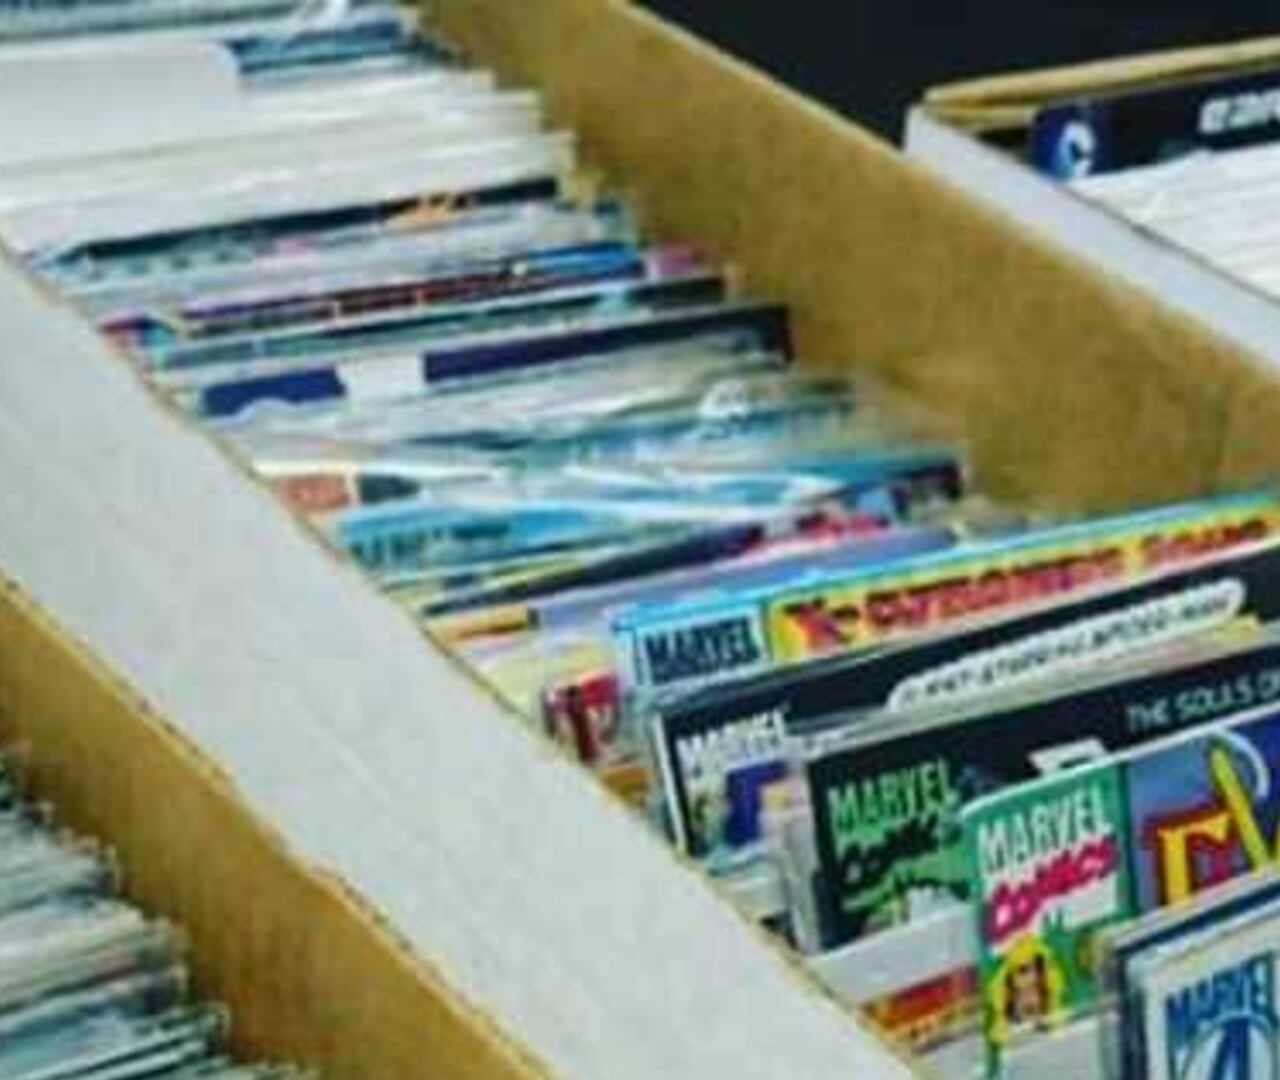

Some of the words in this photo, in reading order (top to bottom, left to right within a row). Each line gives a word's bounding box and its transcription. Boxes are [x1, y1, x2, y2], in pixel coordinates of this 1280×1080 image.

[644, 614, 759, 682] MARVEL
[827, 757, 960, 861] MARVEL
[977, 783, 1114, 878] MARVEL
